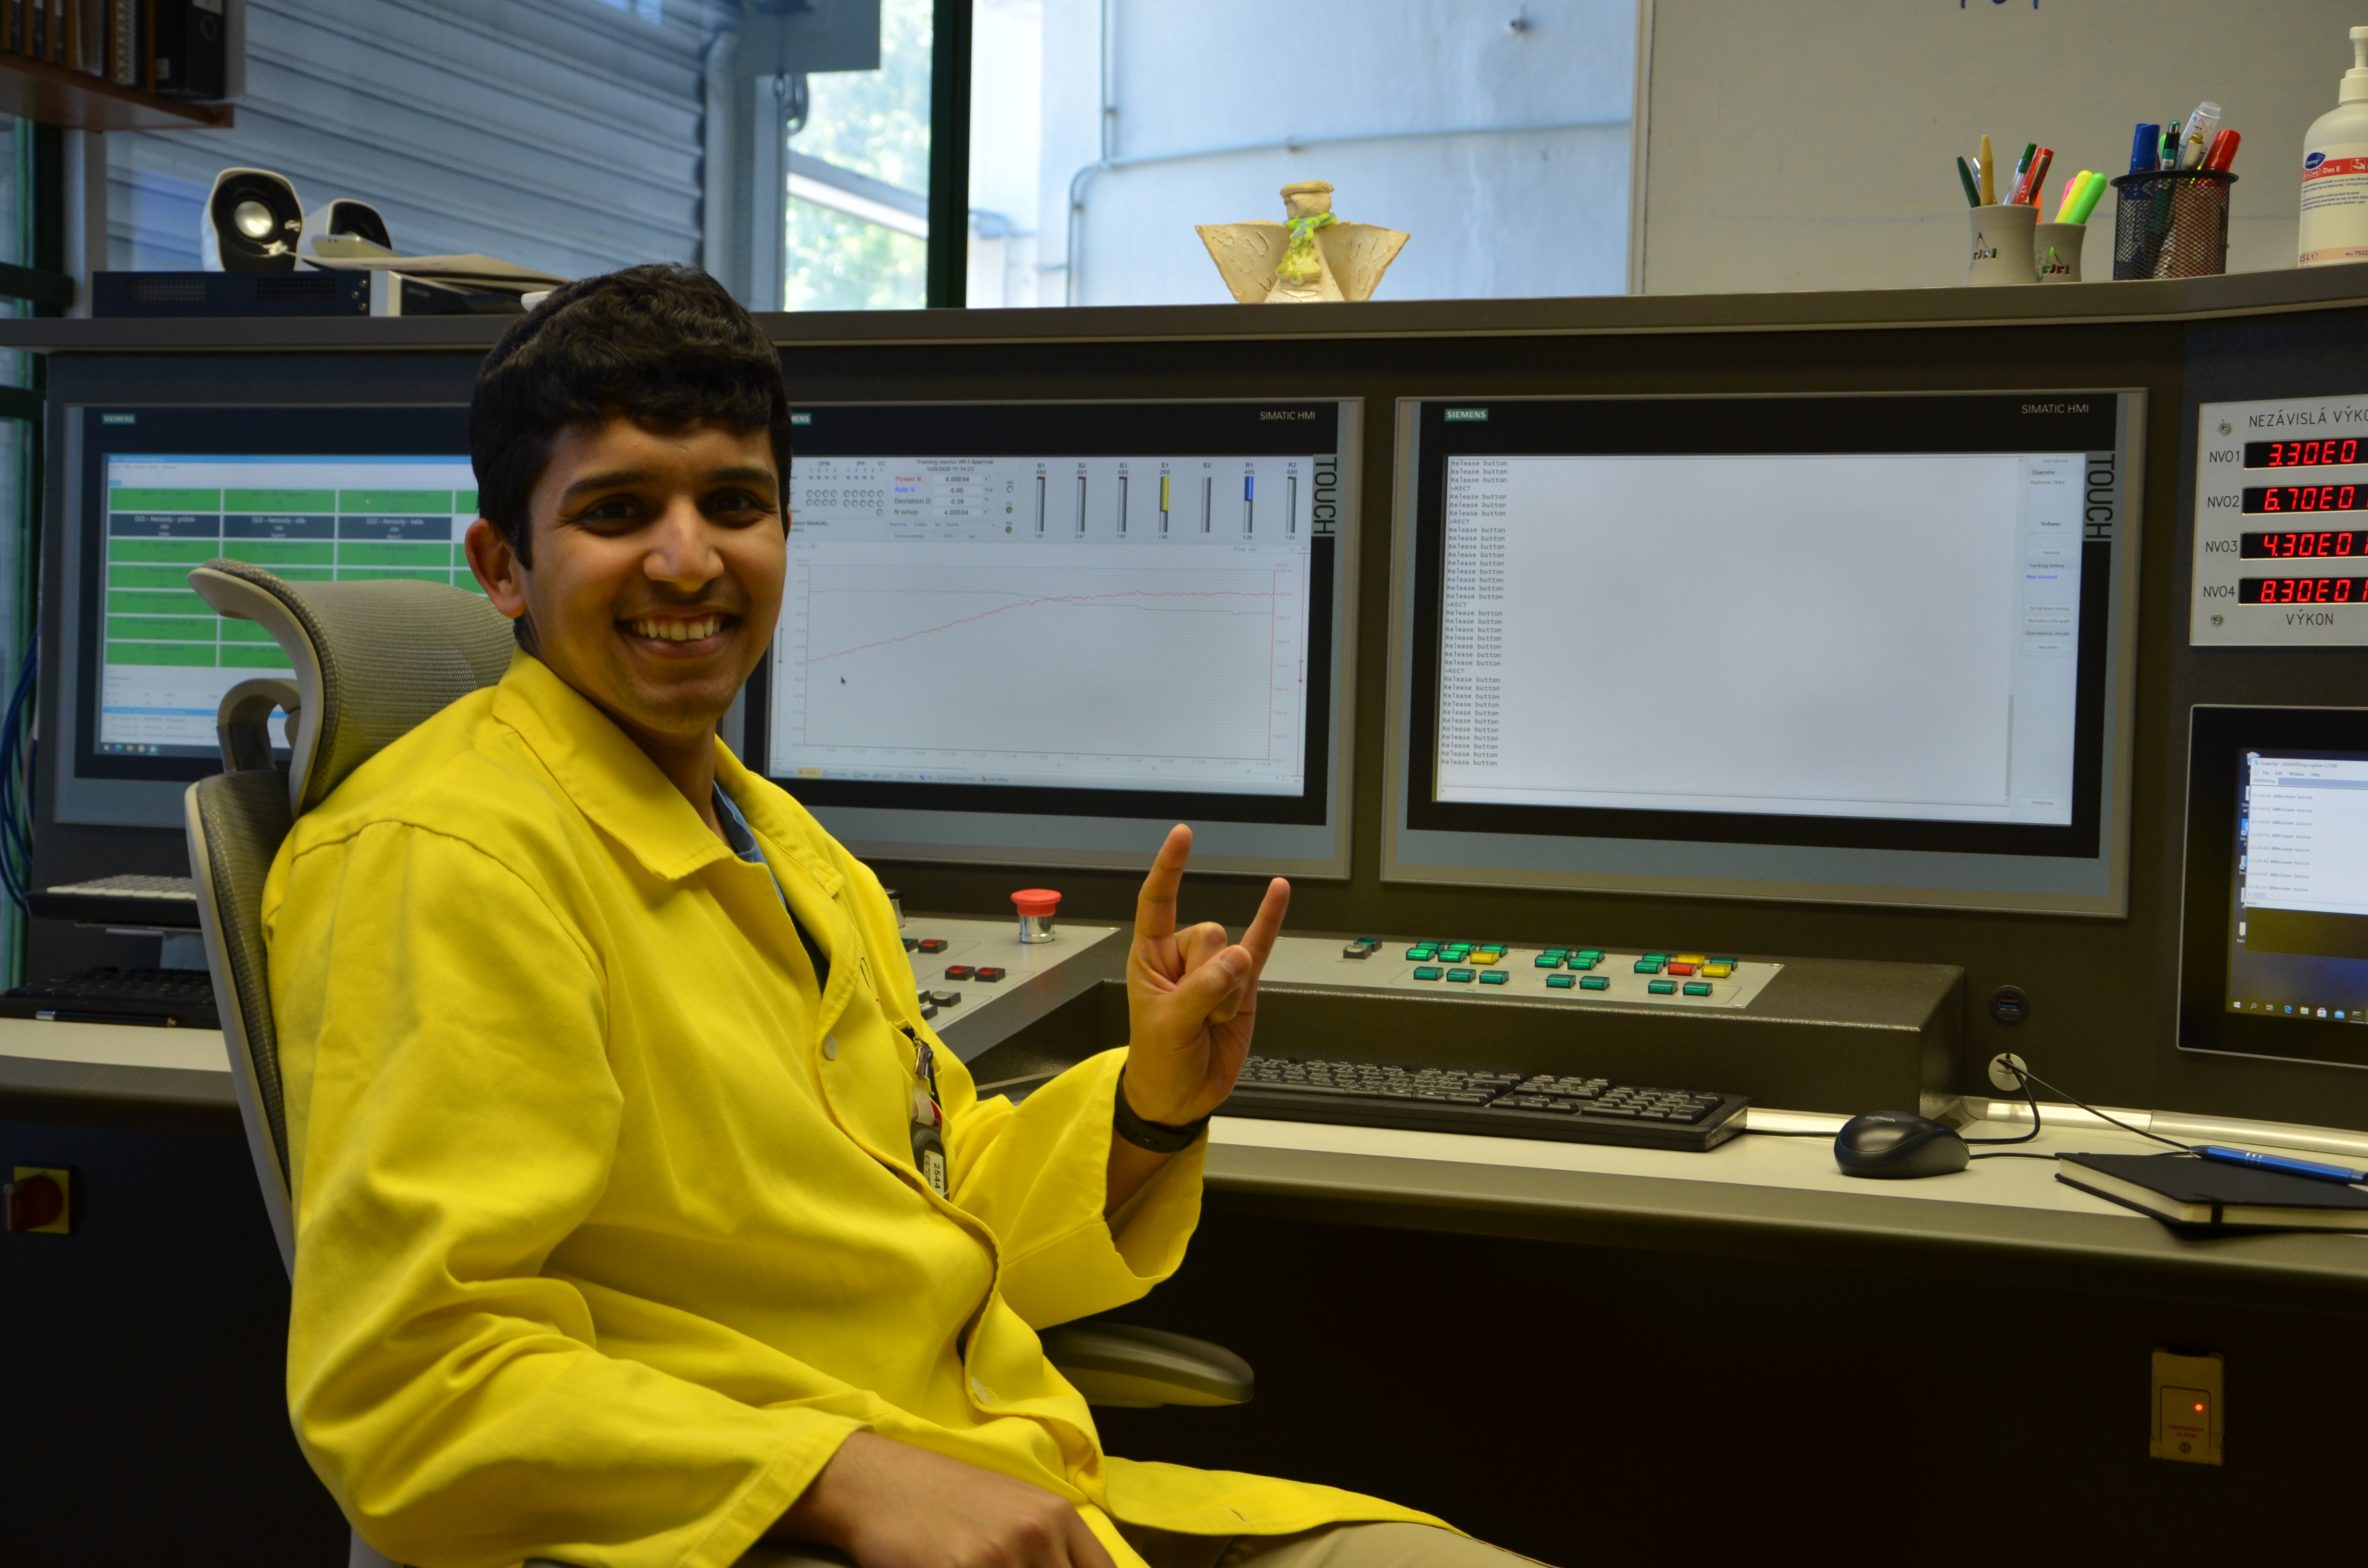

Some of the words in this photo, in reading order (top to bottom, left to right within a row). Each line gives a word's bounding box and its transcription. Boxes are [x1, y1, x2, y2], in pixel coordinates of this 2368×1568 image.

[1260, 411, 1295, 420] SIMATIC
[1298, 411, 1315, 420] HMI
[2022, 404, 2064, 414] SIMATIC
[2068, 404, 2089, 413] HMI
[2249, 407, 2327, 427] NEZÁVISLÁ
[1313, 457, 1337, 534] TOUCH
[2085, 453, 2115, 539] TOUCH
[2264, 486, 2368, 511] 6.70E0
[2286, 609, 2333, 625] VÝKON
[2168, 1424, 2204, 1433] EMERGENCY
